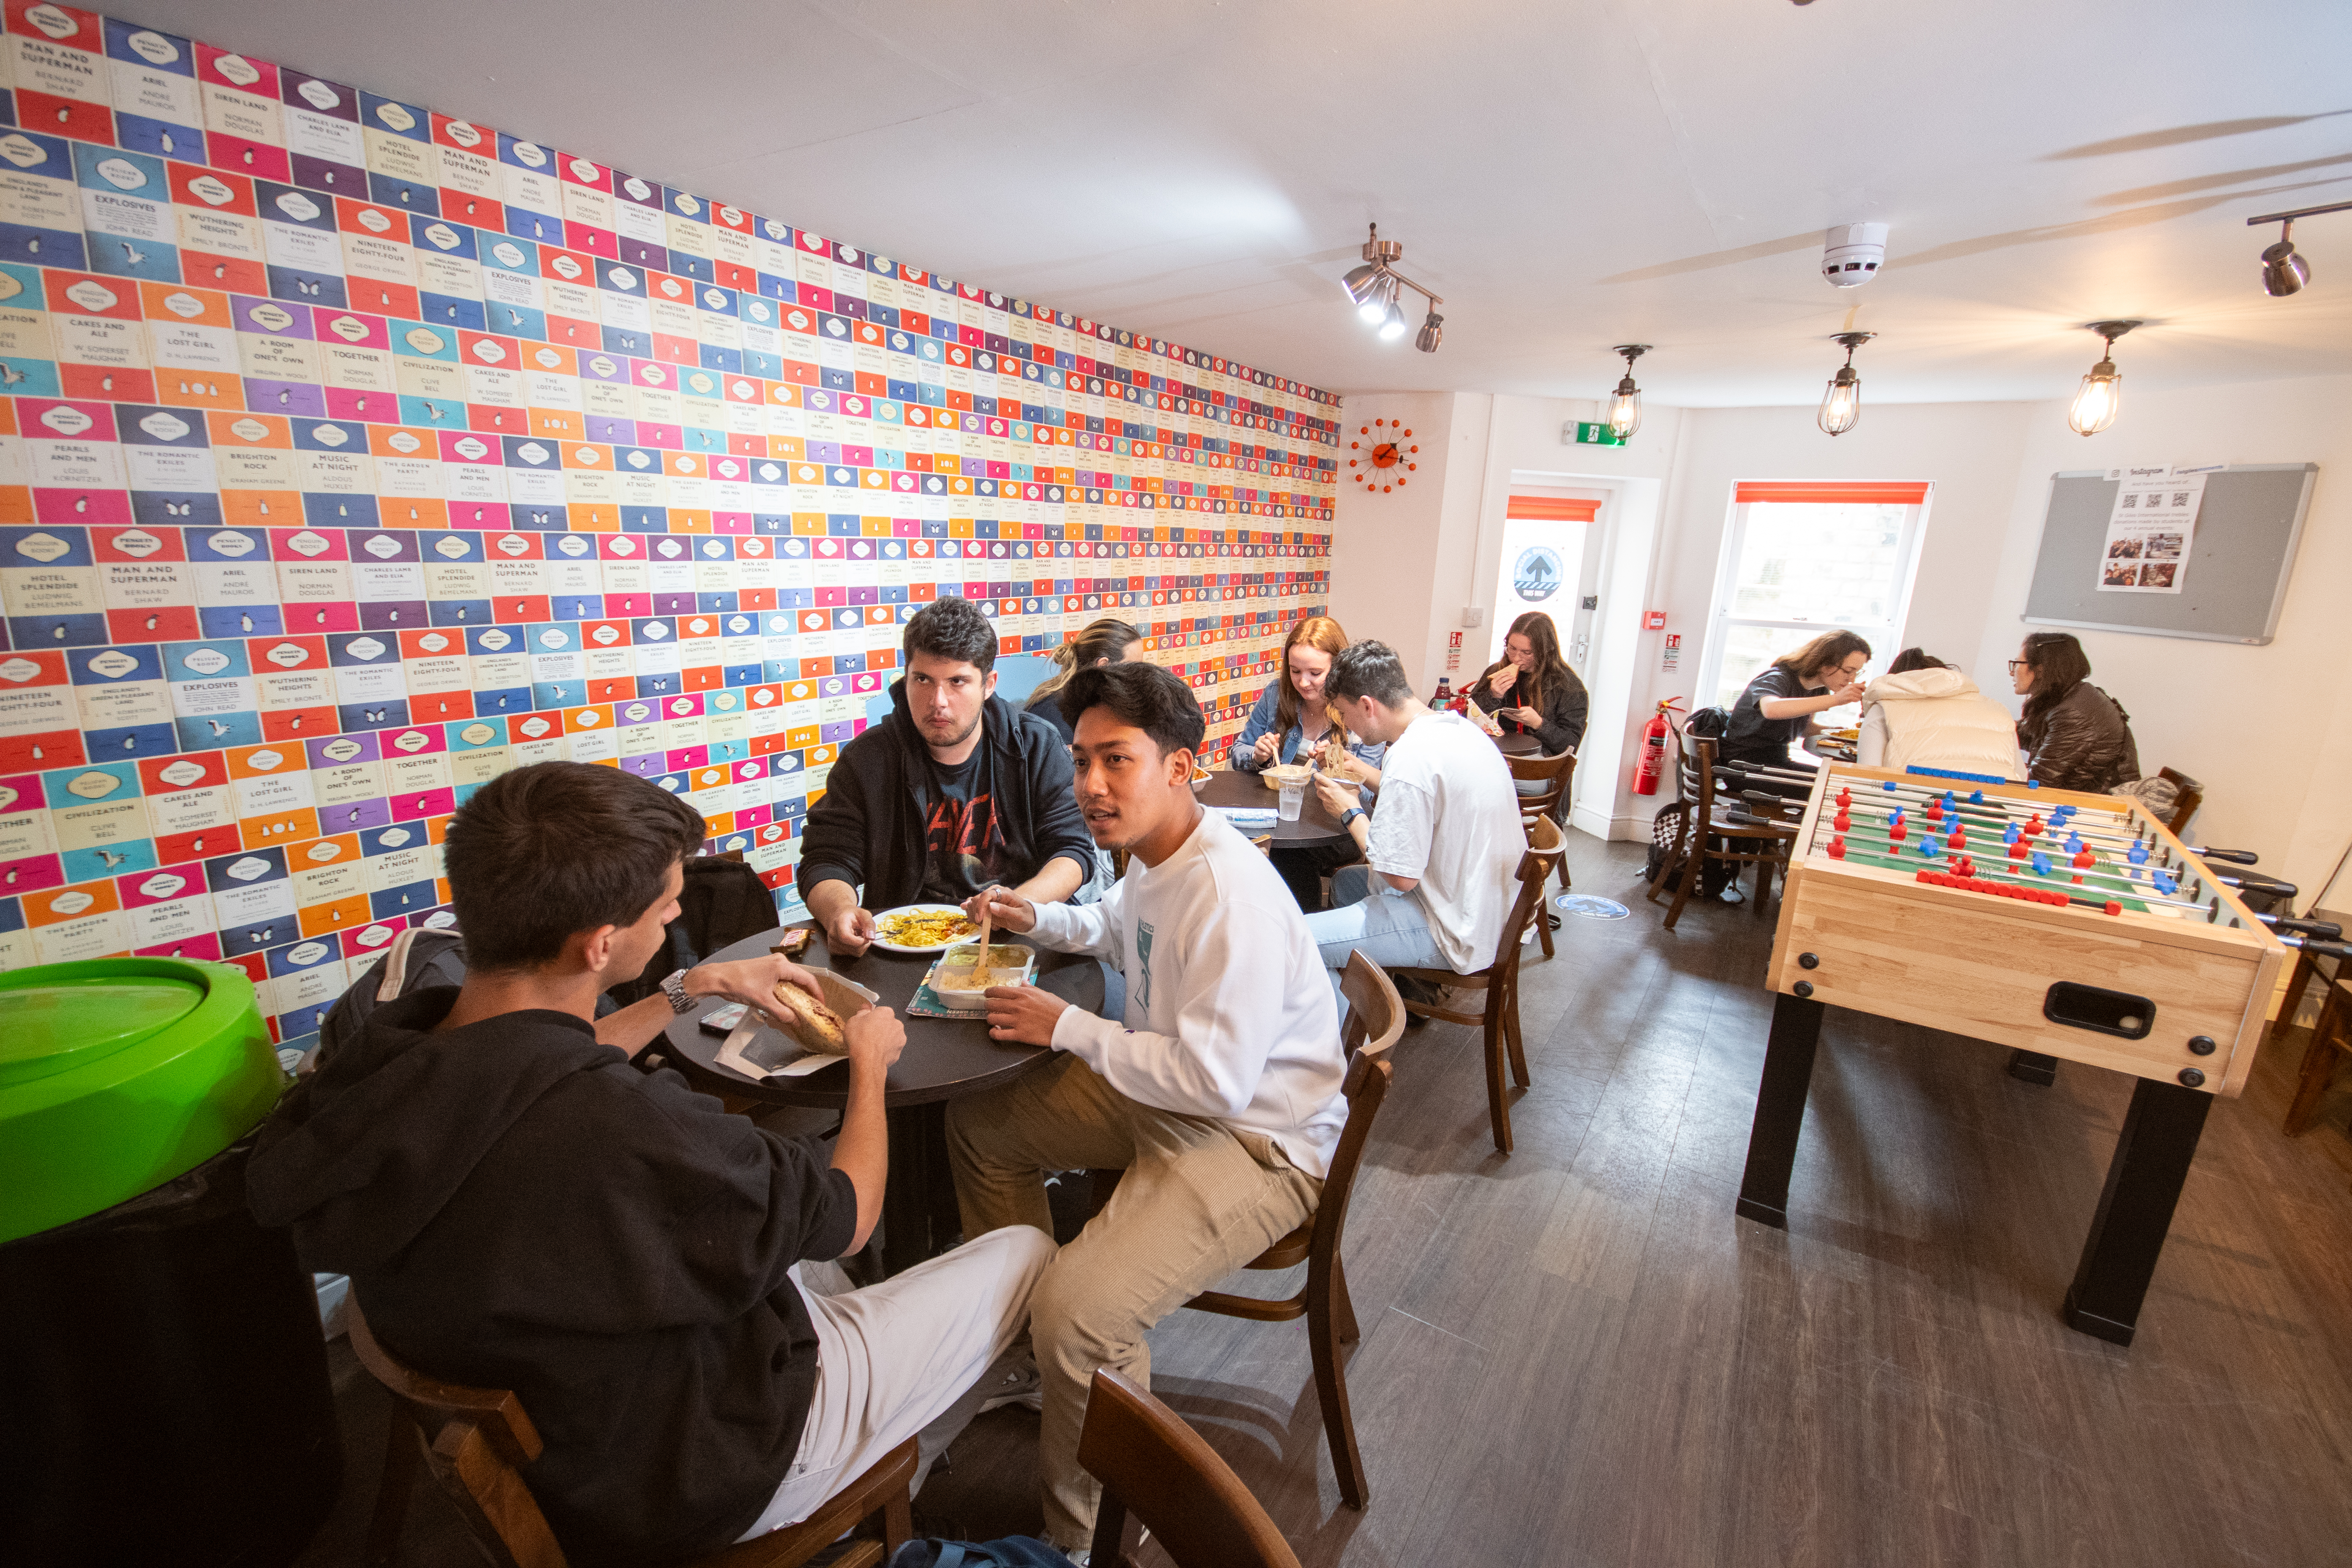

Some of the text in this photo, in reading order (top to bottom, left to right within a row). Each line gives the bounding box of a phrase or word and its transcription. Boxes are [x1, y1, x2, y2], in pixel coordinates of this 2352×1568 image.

[23, 42, 89, 64] MAN AND
[21, 51, 93, 76] SUPERMAN
[142, 76, 168, 88] ARIEL
[213, 92, 268, 112] SIREN LAND
[296, 113, 350, 132] CHARLES LAMB
[308, 124, 341, 137] AND ELIA
[385, 139, 411, 152] HOTEL
[377, 145, 420, 161] SPLENDIDE
[444, 149, 487, 167] MAN AND
[385, 156, 416, 169] LUDWIG
[442, 158, 490, 177] SUPERMAN
[452, 173, 485, 186] BERNARD
[522, 176, 539, 185] ARIEL
[459, 182, 479, 192] SHAW
[520, 194, 544, 204] MAUROIS
[570, 189, 604, 203] SIREN LAND
[93, 193, 156, 212] EXPLOSIVES
[188, 213, 245, 229] WUTHERING
[105, 223, 153, 237] JOHN READ
[199, 223, 237, 236] HEIGHTS
[191, 237, 214, 246] EMILY
[290, 230, 329, 242] ROMANTIC
[290, 237, 315, 246] EXILES
[357, 239, 397, 252] NINETEEN
[351, 247, 405, 262] EIGHTY-FOUR
[355, 262, 406, 276] GEORGE ORWELL
[491, 271, 531, 285] EXPLOSIVES
[552, 285, 588, 297] WUTHERING
[558, 293, 583, 302] HEIGHTS
[68, 318, 125, 331] CAKES AND
[747, 325, 773, 335] EXPLOSIVES
[90, 329, 109, 338] ALE
[179, 330, 199, 338] THE
[166, 338, 215, 349] LOST GIRL
[253, 353, 304, 364] ONE'S OWN
[332, 350, 380, 362] TOGETHER
[344, 368, 373, 376] NORMAN
[403, 361, 453, 373] CIVILIZATION
[343, 375, 377, 384] DOUGLAS
[485, 389, 512, 397] SOMERSET
[641, 392, 672, 401] TOGETHER
[482, 396, 510, 404] MAUGHAM
[2130, 468, 2164, 477] Instagram
[1515, 548, 1562, 582] SOCIAL DISTANCING
[109, 575, 178, 583] SUPERMAN
[182, 681, 238, 691] EXPLOSIVES
[267, 676, 318, 685] WUTHERING
[395, 758, 438, 769] TOGETHER
[384, 852, 411, 862] MUSIC
[392, 857, 419, 867] NIGHT
[306, 868, 348, 881] BRIGHTON
[318, 877, 339, 886] ROCK
[1560, 896, 1625, 912] SOCIAL DISTANCING
